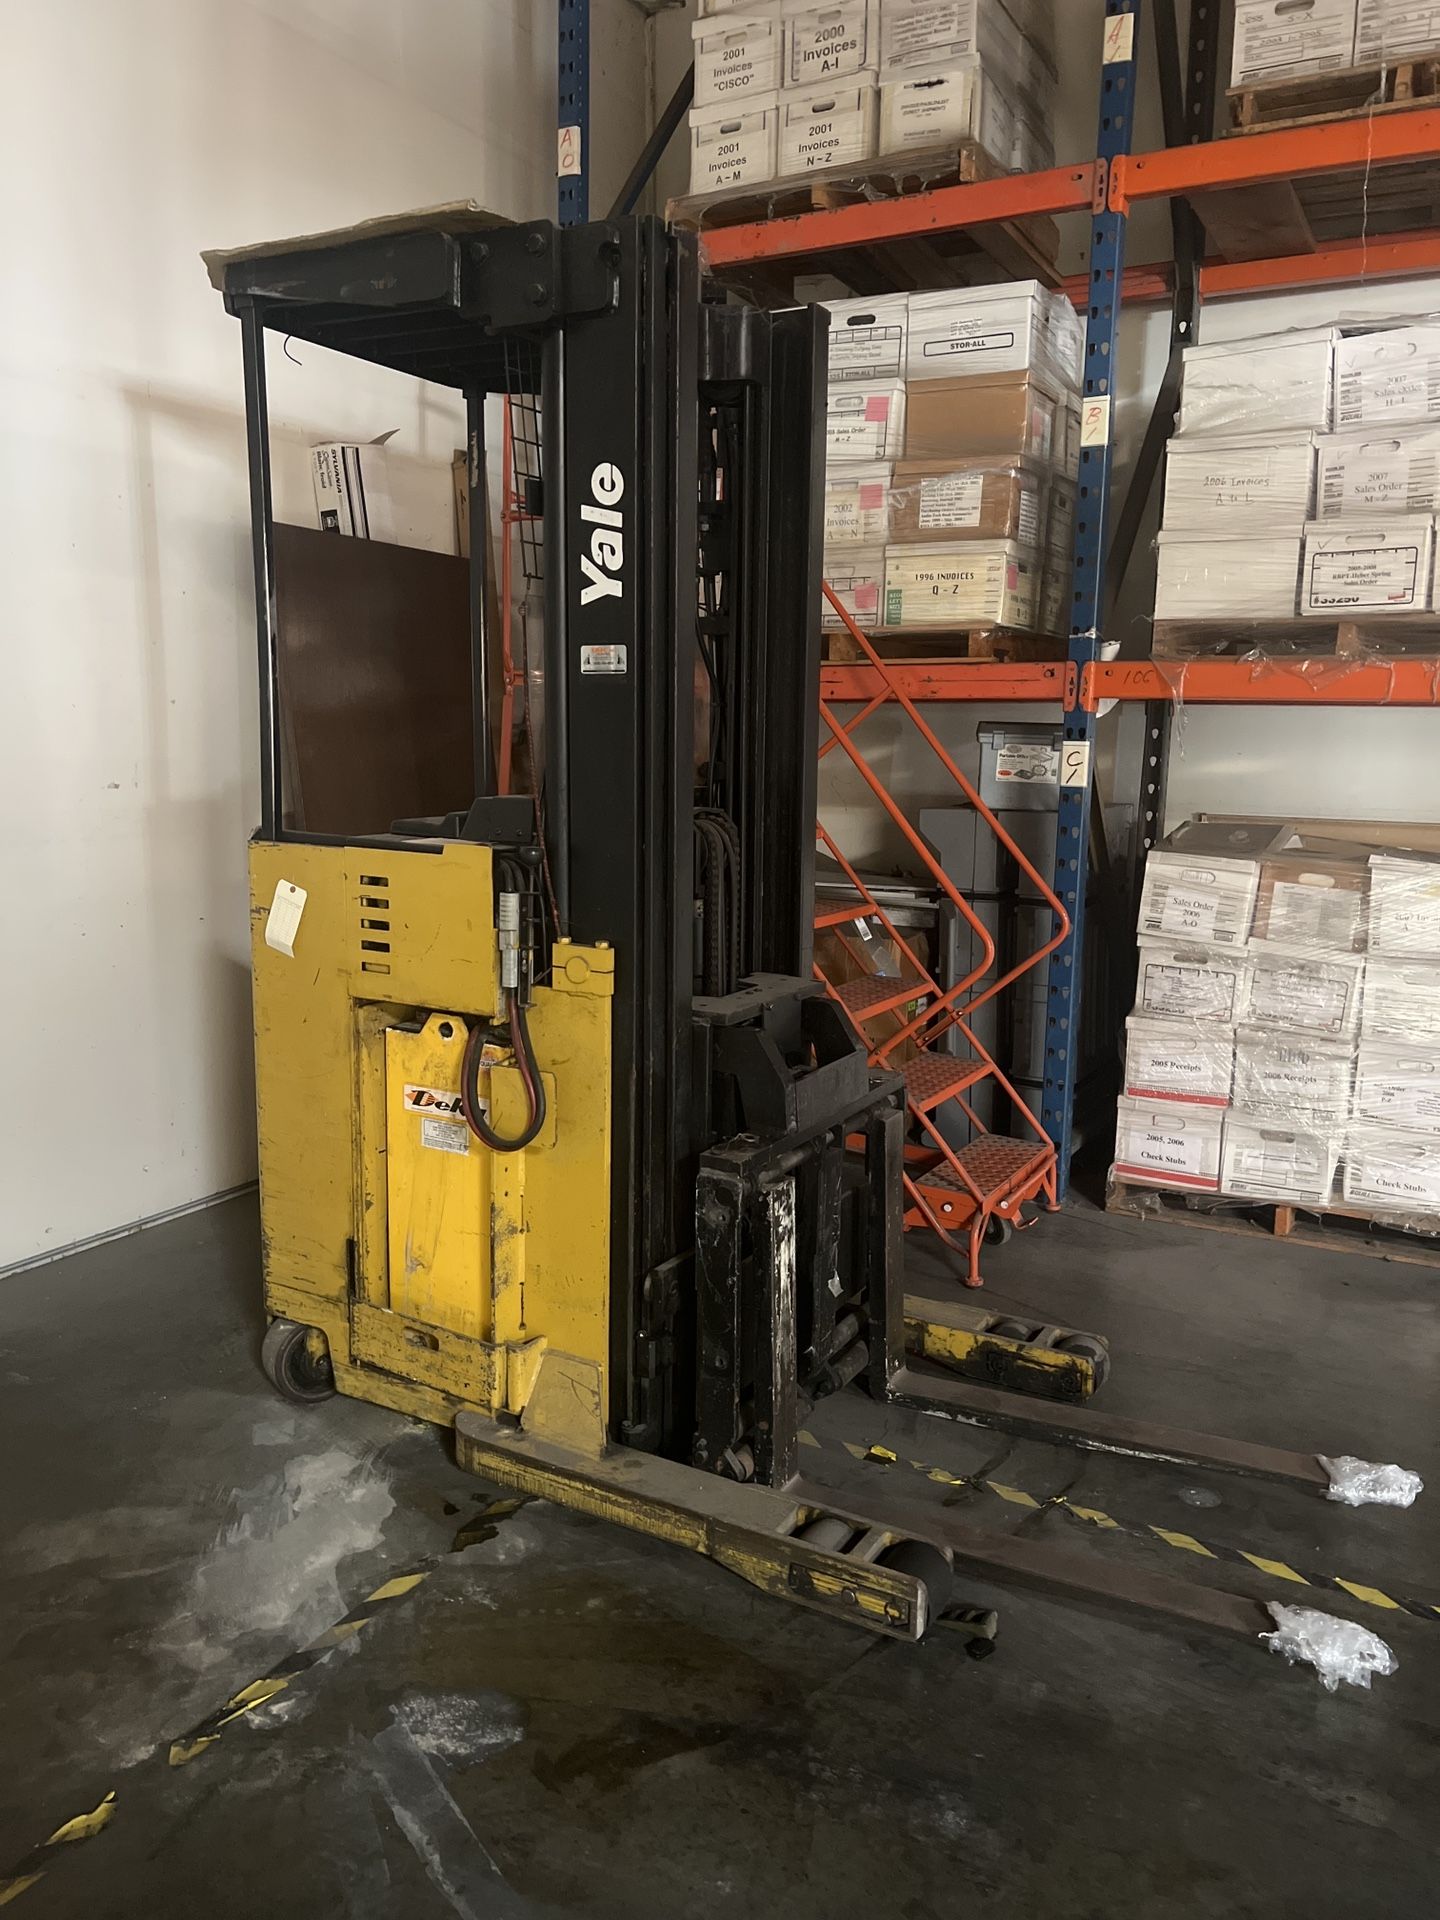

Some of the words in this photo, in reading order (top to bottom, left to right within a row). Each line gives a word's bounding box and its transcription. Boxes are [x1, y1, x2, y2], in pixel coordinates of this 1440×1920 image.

[814, 24, 845, 44] 2000
[1107, 15, 1125, 44] A
[723, 47, 746, 61] 2001
[803, 38, 857, 62] Invoices
[713, 61, 753, 78] Invoices
[821, 56, 839, 73] A-I
[713, 74, 756, 91] "CISCO"
[808, 123, 833, 136] 2001
[560, 128, 572, 149] A
[798, 138, 840, 153] Invoices
[717, 142, 740, 156] 2001
[708, 155, 747, 173] Invoices
[807, 157, 815, 167] N
[825, 152, 833, 163] Z
[716, 175, 723, 185] A
[732, 170, 741, 181] M
[1085, 407, 1102, 425] B
[331, 448, 343, 494] SYLVANIA
[1368, 472, 1389, 482] 2007
[1354, 486, 1377, 494] Sales
[1378, 482, 1403, 491] Order
[1364, 495, 1374, 503] M
[833, 503, 853, 514] 2002
[826, 517, 859, 527] Invoices
[580, 462, 625, 606] Yale
[850, 528, 858, 538] N
[915, 573, 934, 581] 1996
[936, 571, 975, 581] INVOICES
[931, 585, 939, 596] Q
[952, 584, 959, 595] Z
[1067, 751, 1083, 766] C
[1172, 897, 1192, 907] Sales
[1193, 902, 1214, 911] Order
[1182, 910, 1200, 918] 2006
[1151, 1059, 1168, 1069] 2005
[1170, 1062, 1202, 1072] Receipts
[1283, 1074, 1317, 1084] Receipts
[1146, 1133, 1166, 1144] 2005,
[1167, 1137, 1185, 1147] 2006
[1140, 1150, 1164, 1162] Check
[1165, 1155, 1187, 1166] Stubs
[1376, 1178, 1402, 1190] Check
[1403, 1183, 1427, 1193] Stubs
